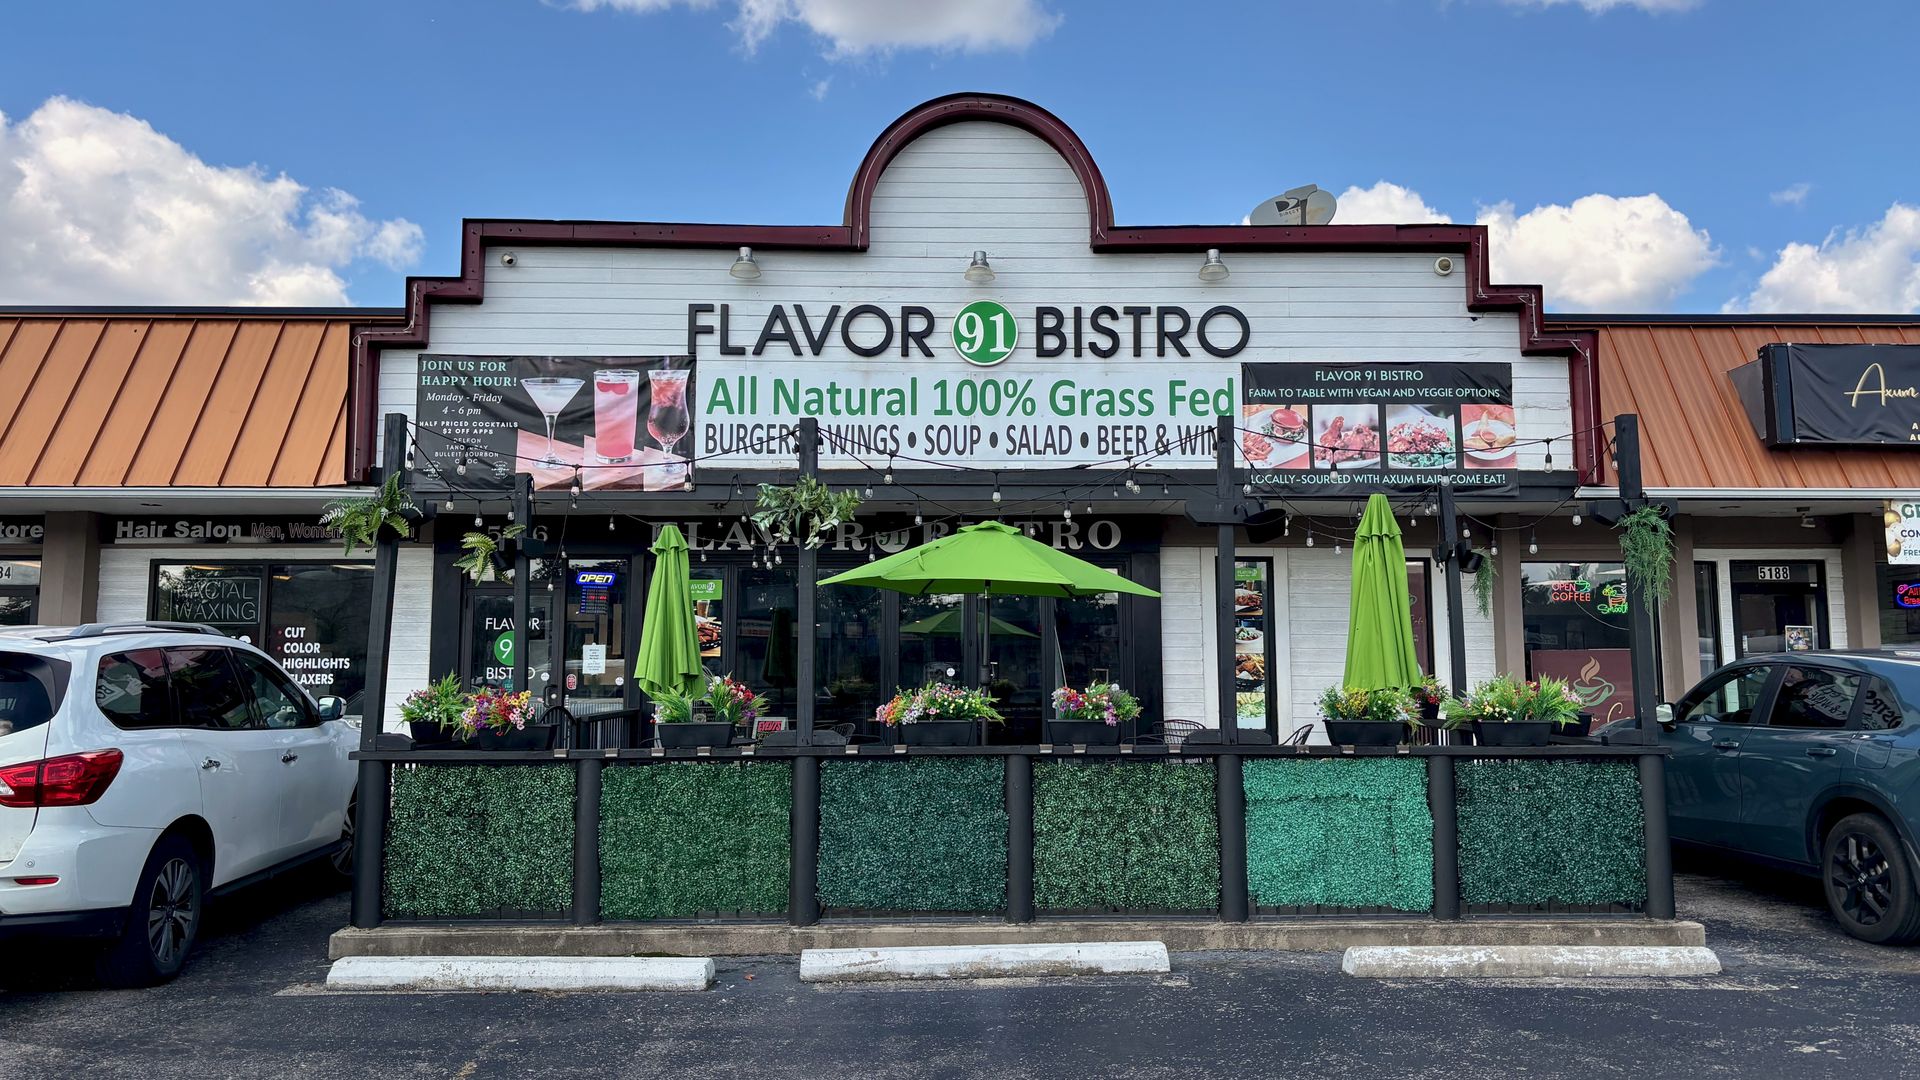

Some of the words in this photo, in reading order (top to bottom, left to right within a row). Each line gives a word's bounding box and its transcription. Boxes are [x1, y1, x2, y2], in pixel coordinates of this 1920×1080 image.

[688, 304, 935, 358] FLAVOR
[958, 312, 1011, 354] 91
[1036, 305, 1250, 358] BISTRO
[422, 360, 452, 372] JOIN
[458, 361, 475, 372] US
[480, 362, 507, 372] FOR
[421, 375, 468, 386] HAPPY
[473, 377, 517, 387] HOUR!
[1315, 370, 1361, 381] FLAVOR
[1365, 370, 1376, 381] 91
[1381, 370, 1424, 381] BISTRO
[1844, 363, 1919, 408] Axum
[426, 392, 464, 404] Monday
[472, 393, 503, 404] Friday
[706, 376, 757, 416] All
[773, 376, 917, 417] Natural
[933, 378, 1036, 417] 100%
[1049, 380, 1155, 417] Grass
[1168, 377, 1234, 417] Fed
[1248, 388, 1277, 398] FARM
[1279, 388, 1294, 398] TO
[1296, 388, 1325, 398] TABLE
[1327, 388, 1354, 398] WITH
[1355, 388, 1390, 397] VEGAN
[1393, 388, 1415, 397] AND
[1417, 388, 1453, 397] VEGGIE
[1455, 388, 1501, 398] OPTIONS
[442, 406, 449, 415] 4
[458, 406, 465, 415] 6
[466, 408, 481, 417] pm
[827, 424, 901, 456] WINGS
[924, 424, 981, 456] SOUP
[1005, 424, 1073, 456] SALAD
[1097, 424, 1148, 456] BEER
[1154, 424, 1170, 456] &
[1177, 425, 1217, 456] WIN
[1353, 474, 1380, 484] WITH
[1382, 474, 1414, 484] AXUM
[1452, 474, 1481, 484] COME
[1483, 474, 1506, 484] EAT!
[116, 521, 168, 538] Hair
[174, 520, 242, 538] Salon
[579, 574, 613, 584] OPEN
[1760, 567, 1789, 579] 5188
[1552, 582, 1576, 591] OPEN
[1552, 592, 1591, 602] COFFEE
[175, 602, 256, 620] WAXING
[284, 627, 306, 639] CUT
[283, 642, 321, 654] COLOR
[282, 658, 350, 669] HIGHLIGHTS
[289, 674, 334, 685] LAXERS
[486, 667, 536, 680] BISTO
